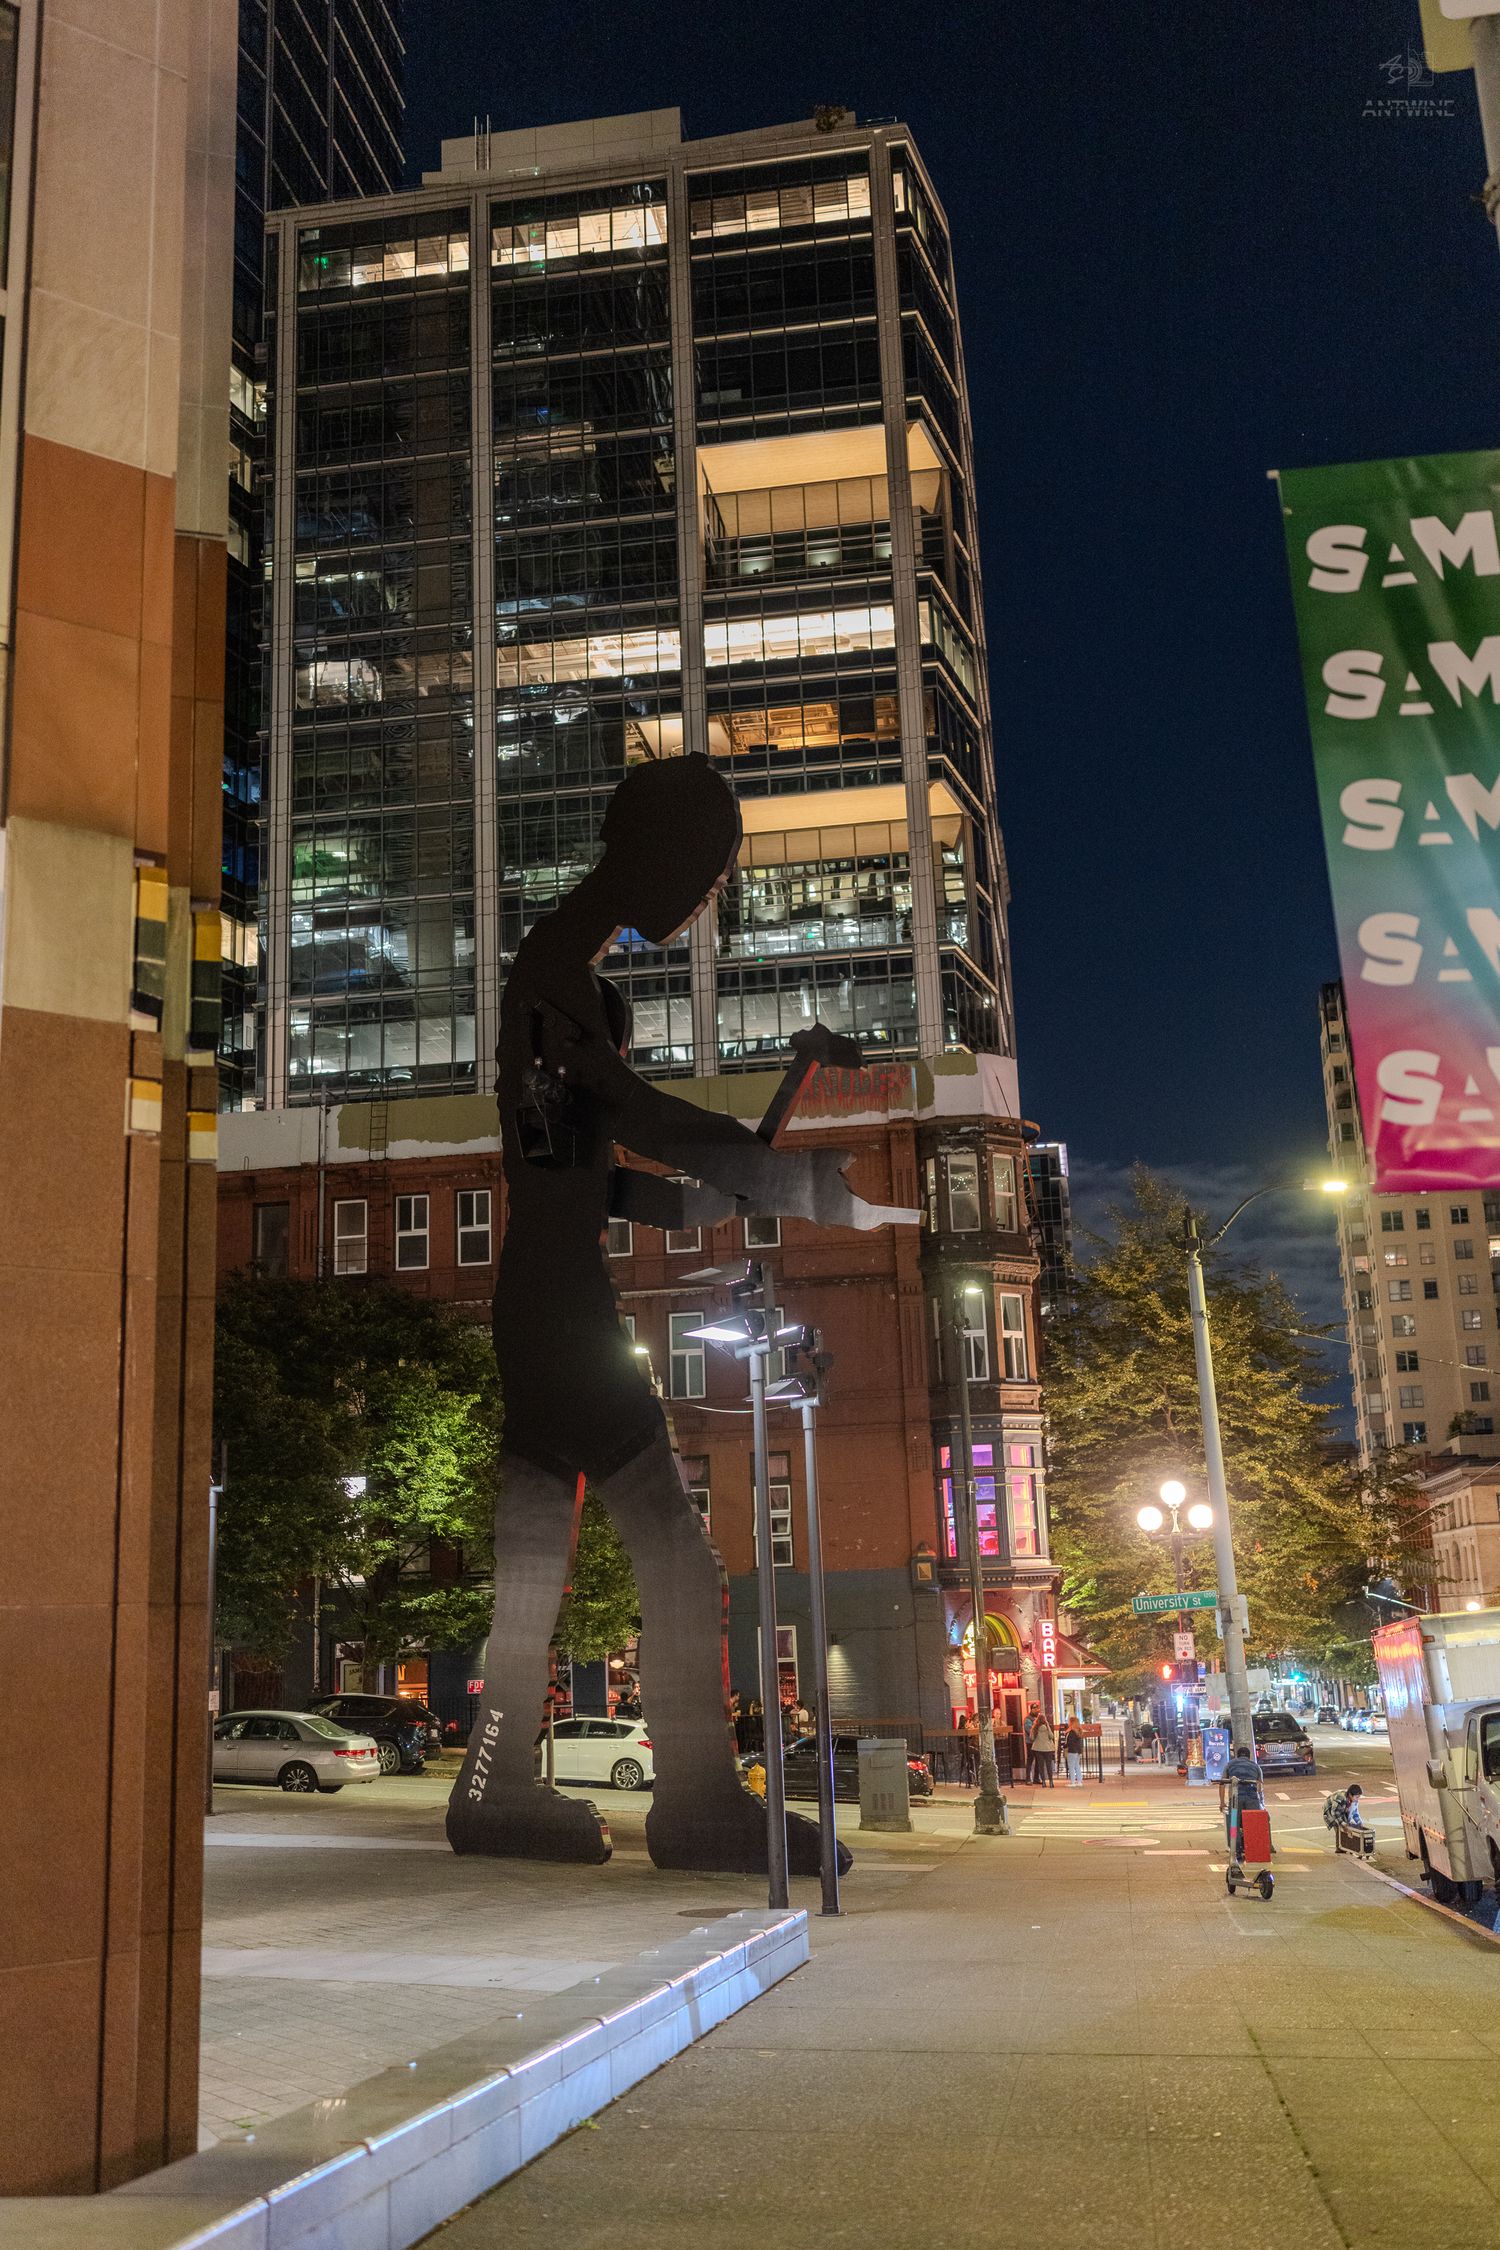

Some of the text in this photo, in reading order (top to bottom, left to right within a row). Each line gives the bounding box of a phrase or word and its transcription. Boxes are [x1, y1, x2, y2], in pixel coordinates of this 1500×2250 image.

[1306, 510, 1500, 593] SAM
[1322, 636, 1500, 720] SAM
[1377, 1047, 1500, 1126] SA
[1135, 1595, 1189, 1611] University
[1192, 1597, 1202, 1606] St
[1041, 1622, 1056, 1667] BAR
[468, 1709, 504, 1802] 3277164
